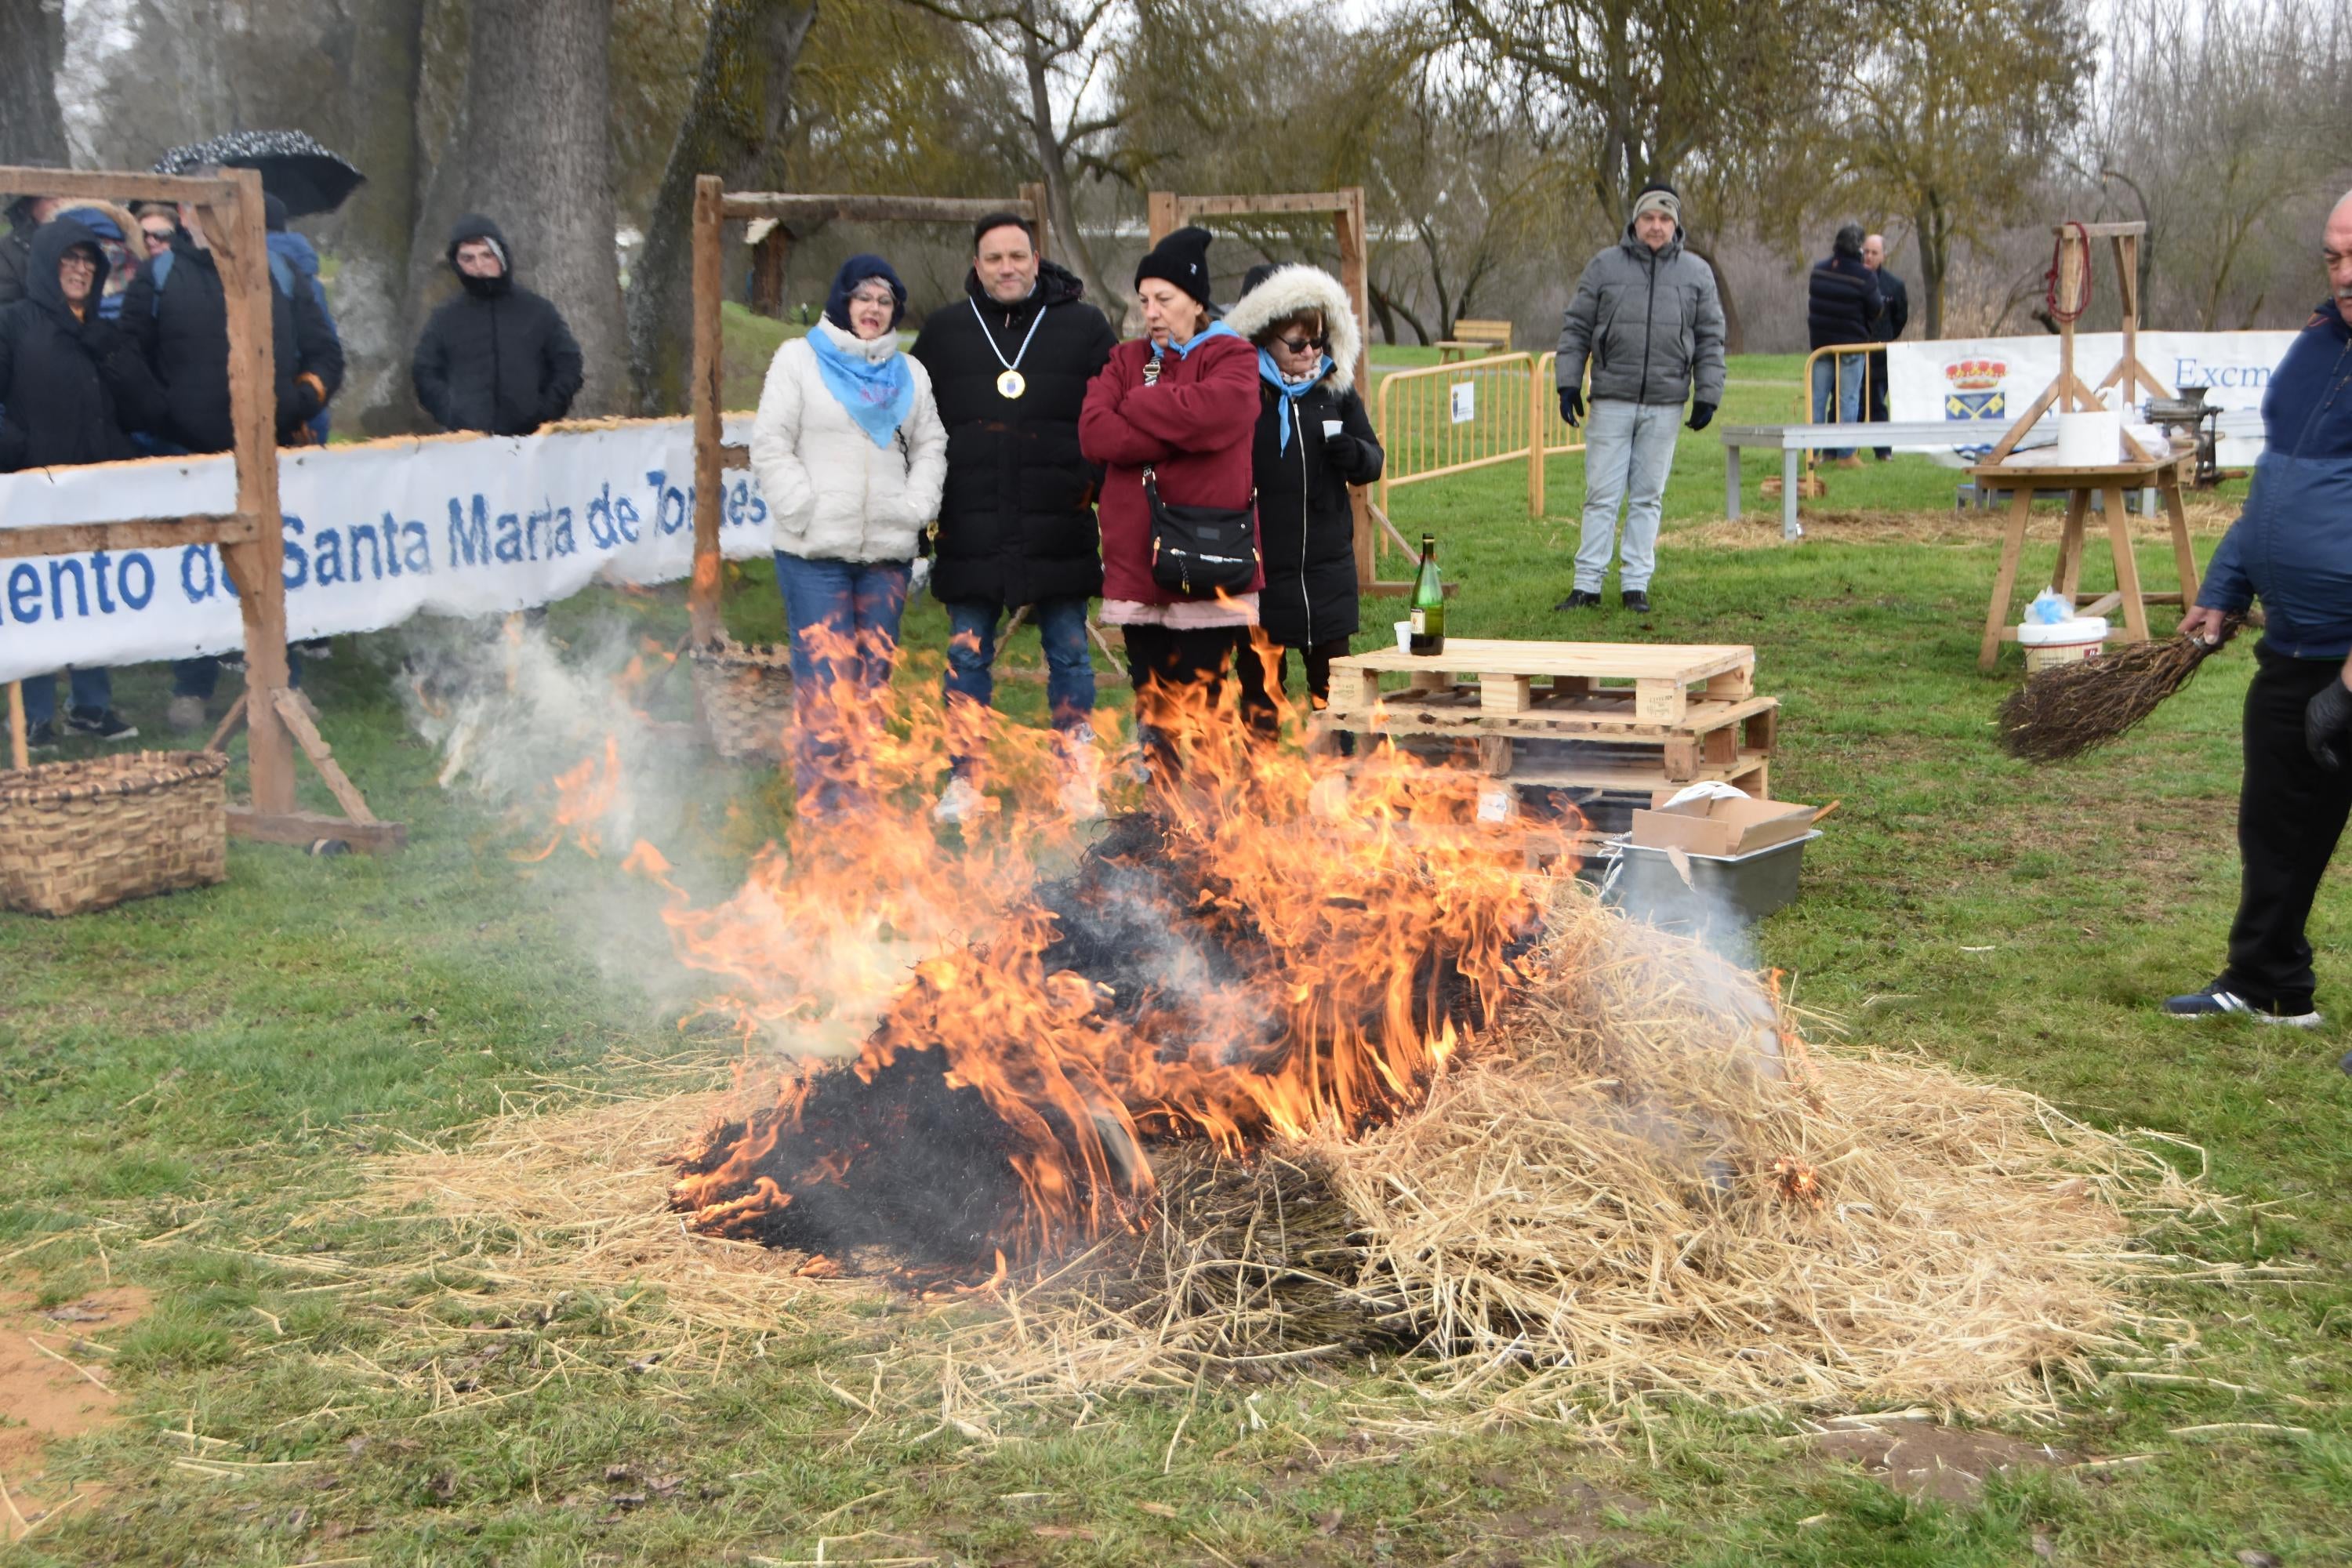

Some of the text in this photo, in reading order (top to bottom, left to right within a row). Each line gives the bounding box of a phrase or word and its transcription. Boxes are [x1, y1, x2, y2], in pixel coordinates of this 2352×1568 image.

[0, 550, 155, 626] ento
[181, 543, 240, 604] d
[282, 510, 432, 590] Santa
[585, 480, 640, 550] de
